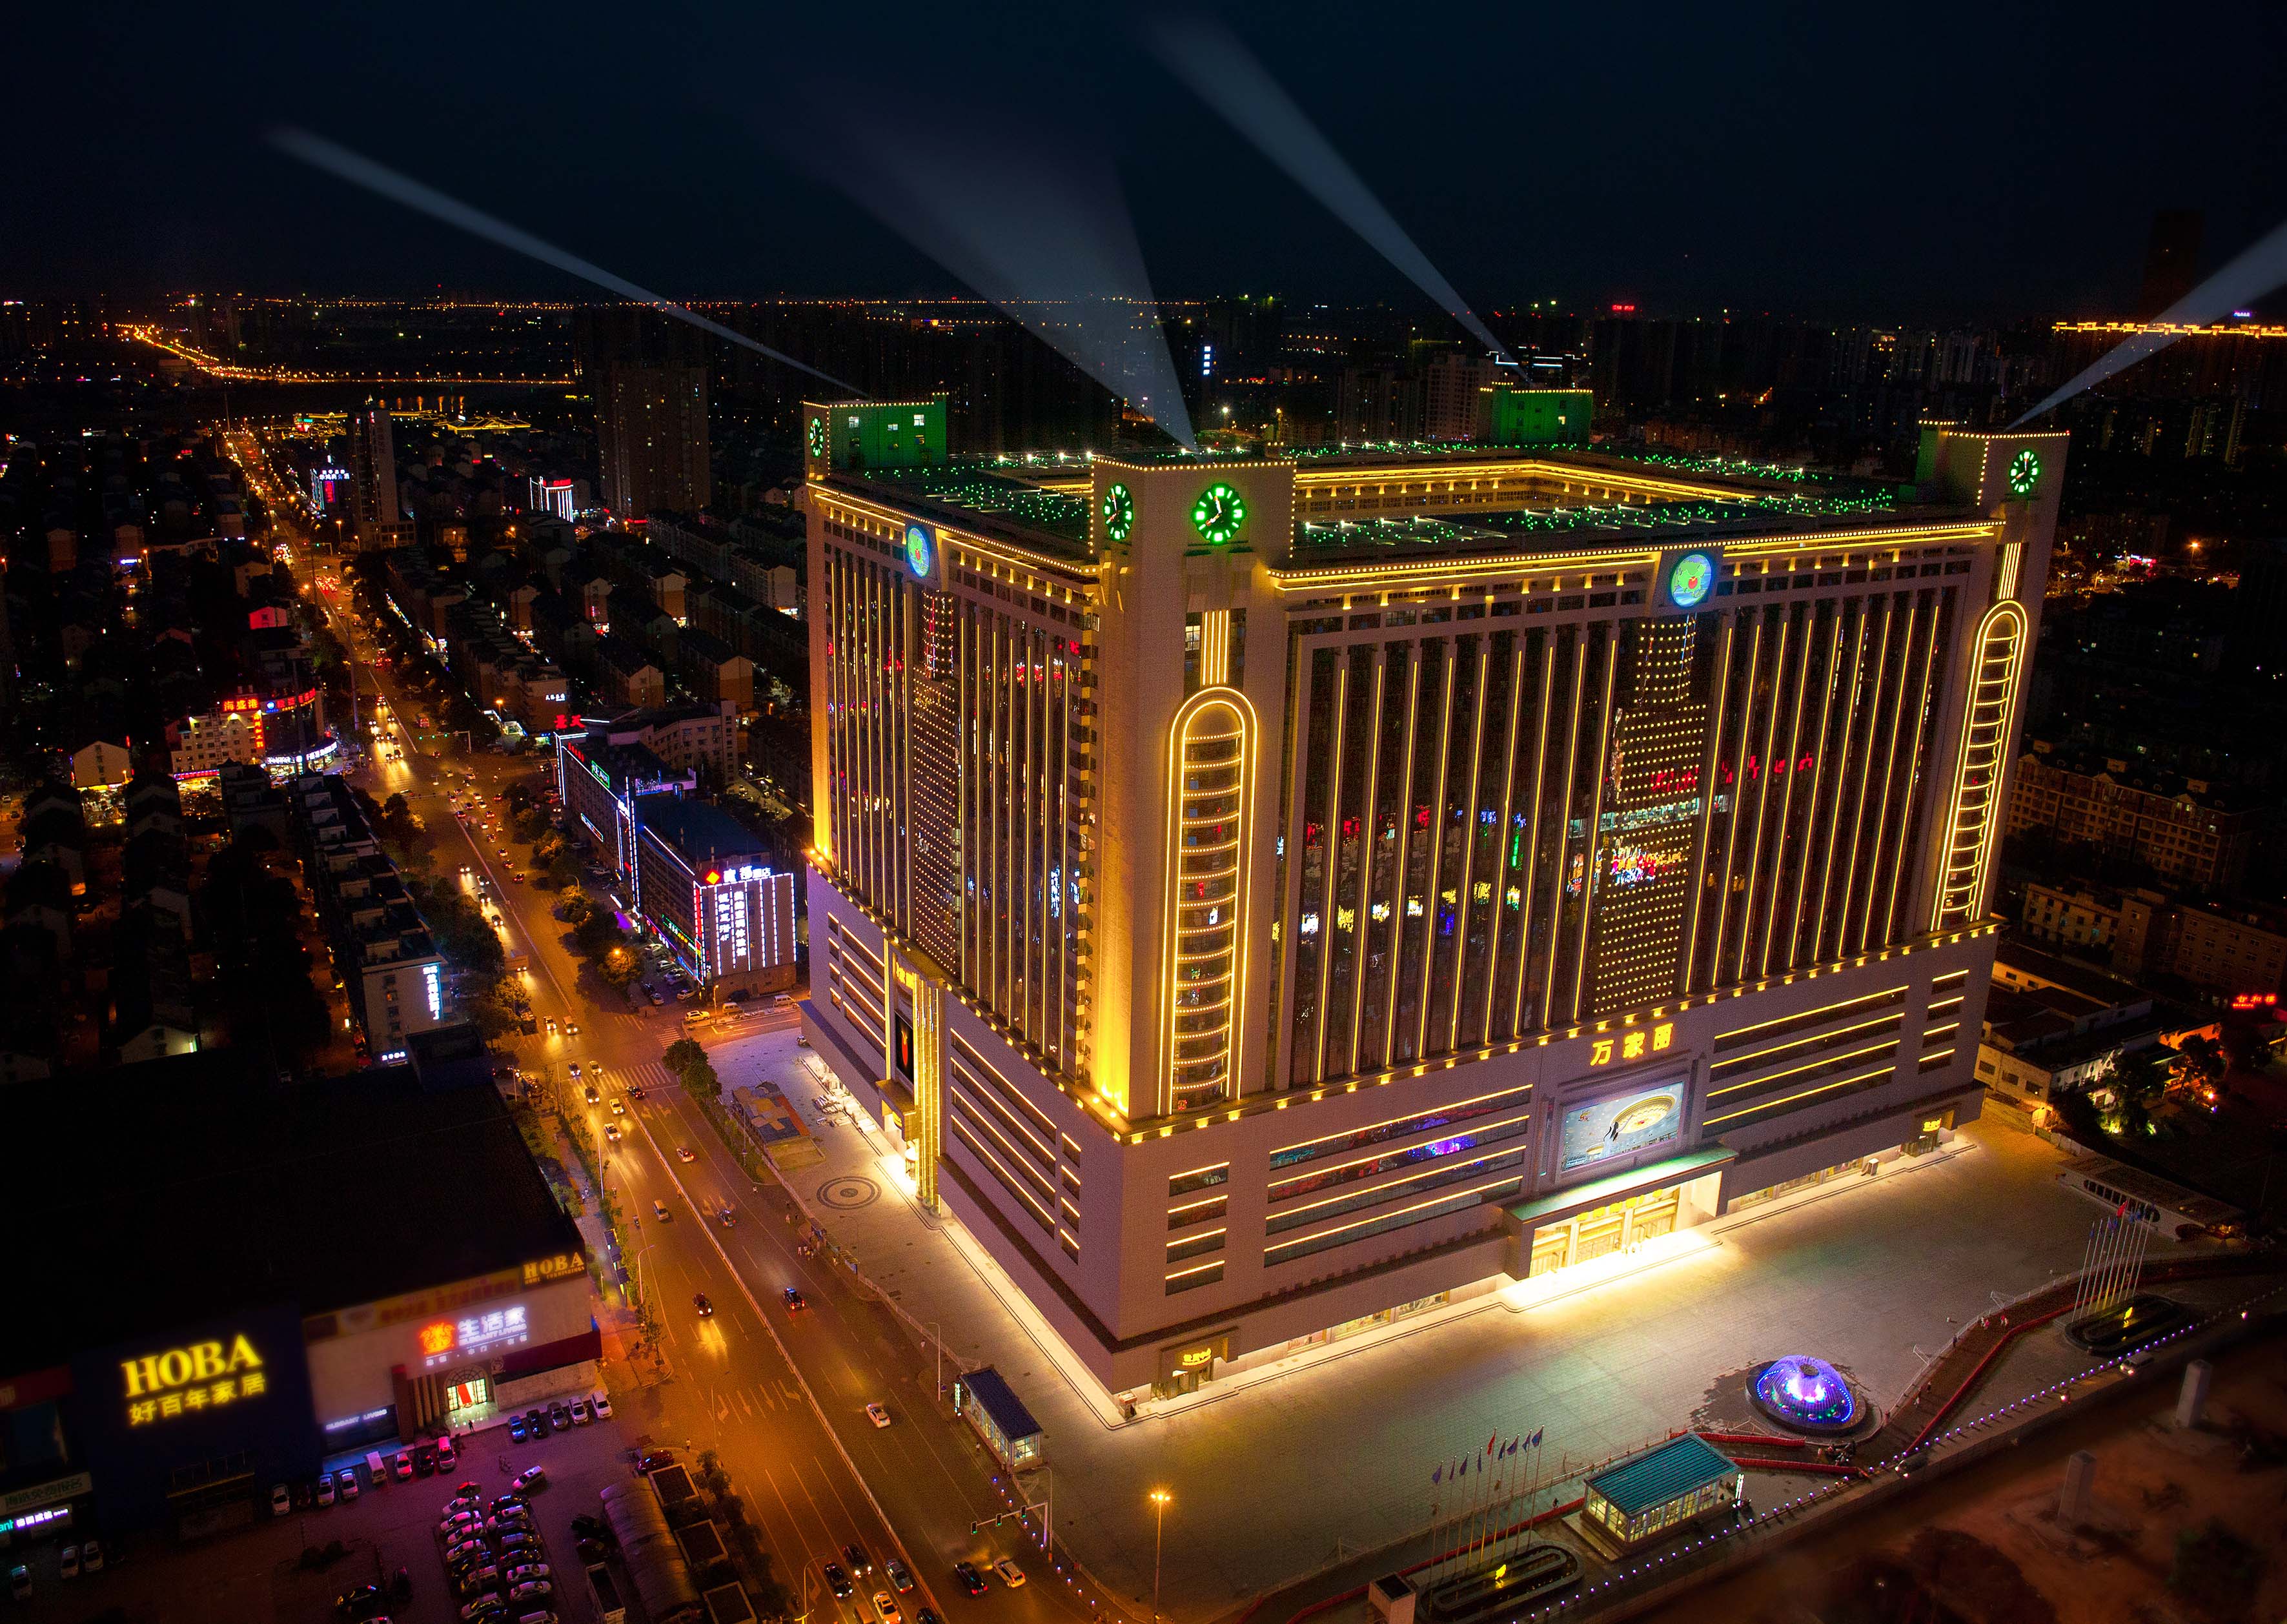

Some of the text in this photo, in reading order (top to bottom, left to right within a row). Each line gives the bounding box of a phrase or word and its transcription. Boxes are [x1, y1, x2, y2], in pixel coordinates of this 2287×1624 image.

[223, 698, 258, 711] 海盛港
[1590, 1023, 1674, 1066] 万家丽
[523, 1252, 584, 1279] HOBA
[458, 1306, 526, 1339] 生活家
[121, 1334, 263, 1397] HOBA
[129, 1372, 265, 1426] 好百年家居
